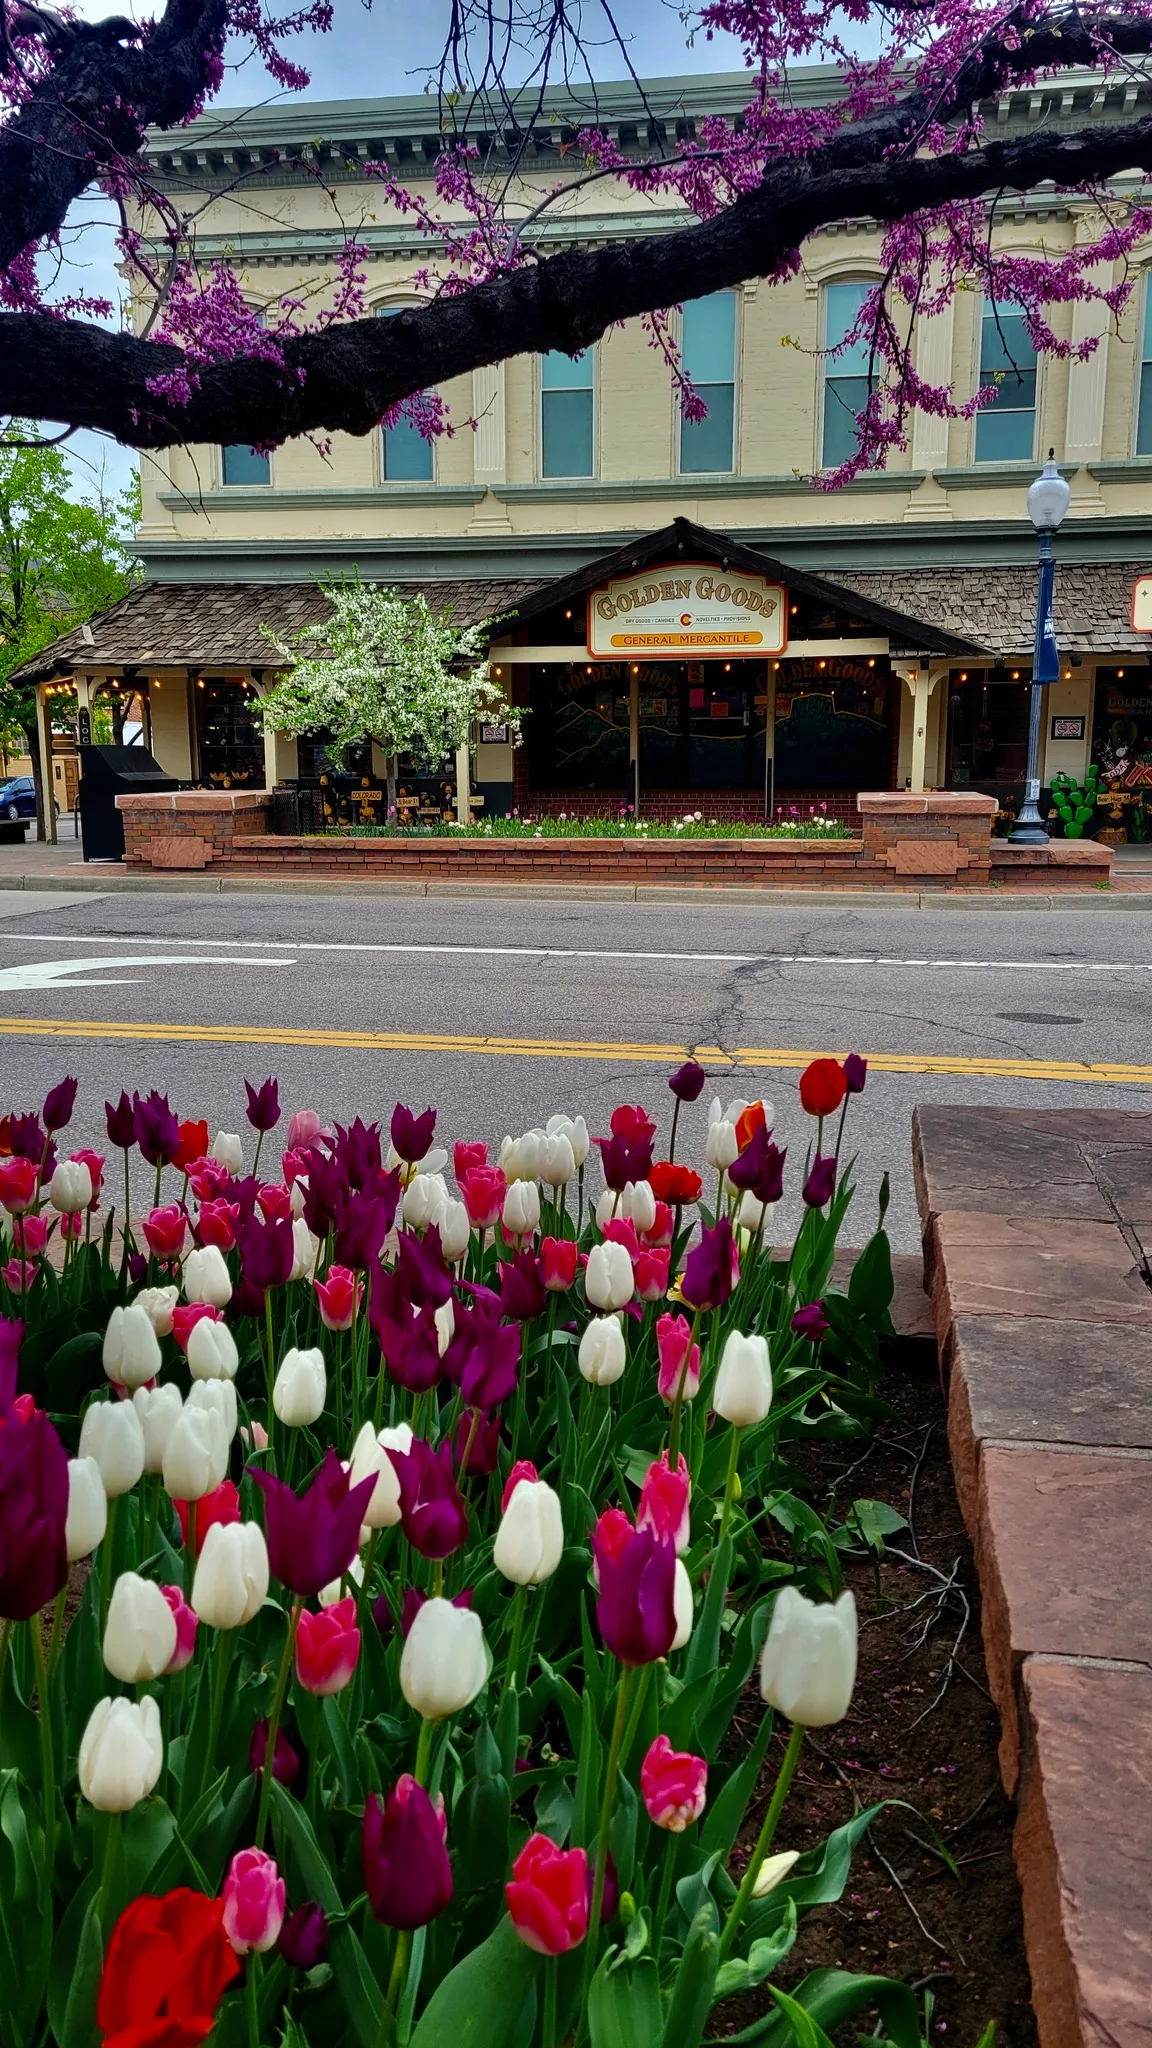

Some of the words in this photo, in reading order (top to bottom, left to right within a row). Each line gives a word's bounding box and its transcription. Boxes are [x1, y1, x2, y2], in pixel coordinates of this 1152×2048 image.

[597, 579, 692, 620] GOLDEN
[695, 576, 777, 618] GOODS
[624, 636, 675, 645] GENERAL
[680, 634, 750, 644] MERCANTILE
